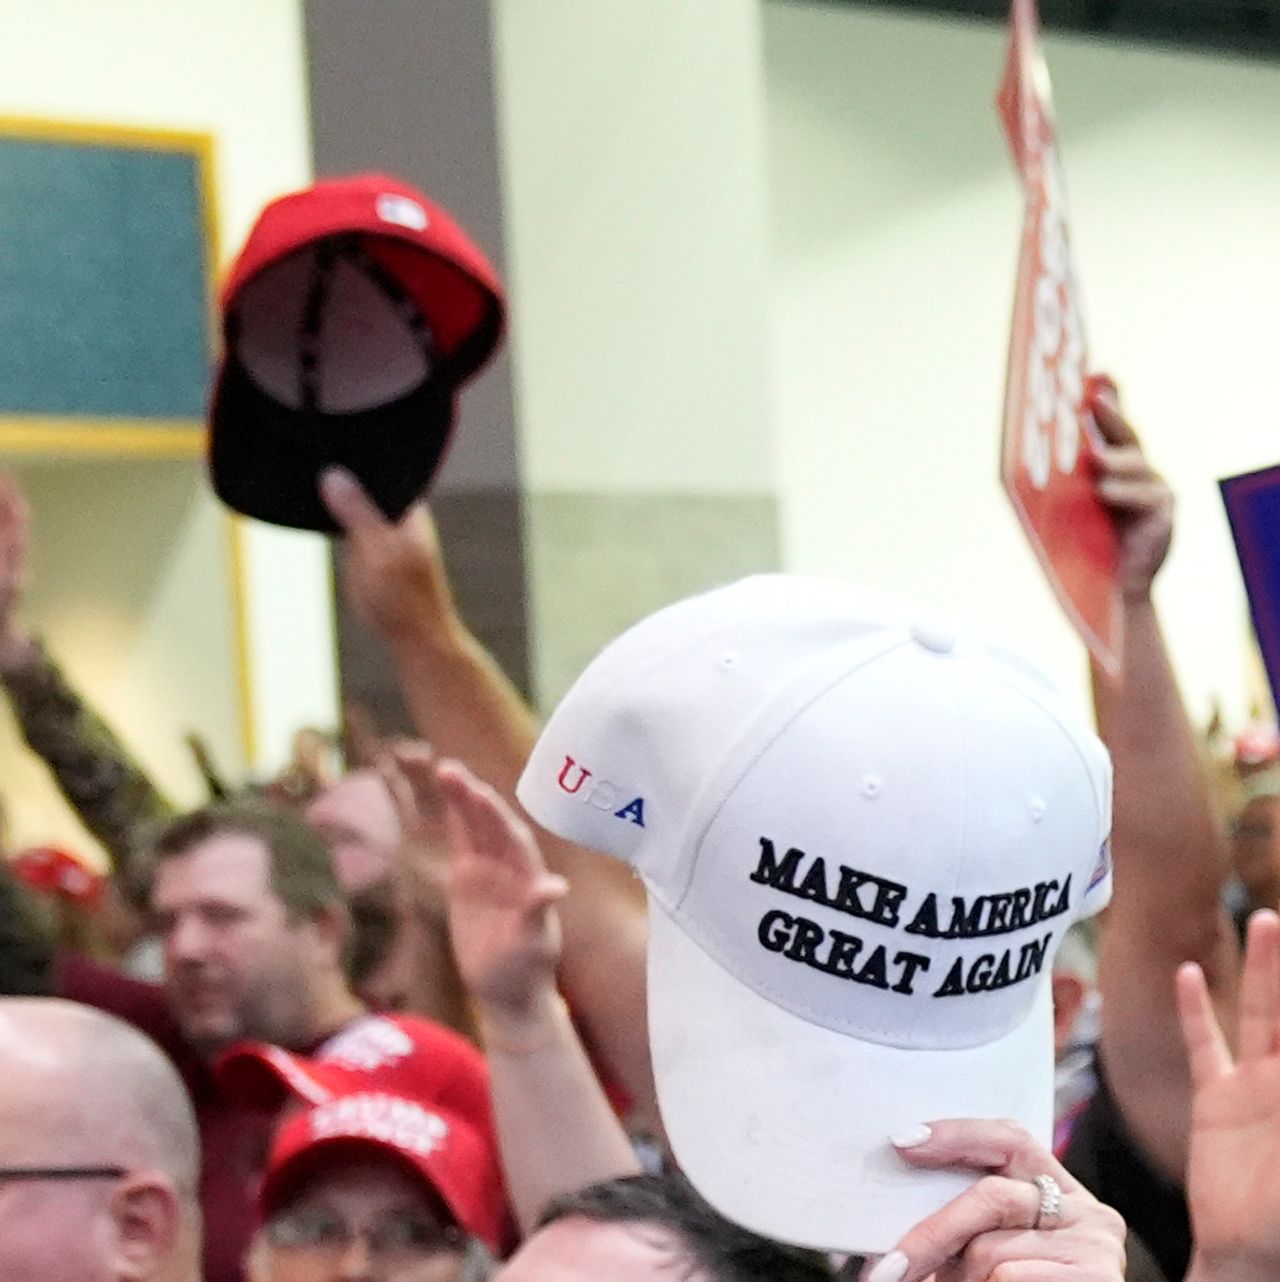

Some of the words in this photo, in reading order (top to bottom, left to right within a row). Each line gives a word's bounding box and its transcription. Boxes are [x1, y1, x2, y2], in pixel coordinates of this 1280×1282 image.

[557, 755, 646, 828] USA
[749, 836, 908, 928] MAKE
[904, 873, 1073, 940] AMERICA
[757, 909, 931, 995] GREAT
[932, 932, 1053, 998] AGAIN
